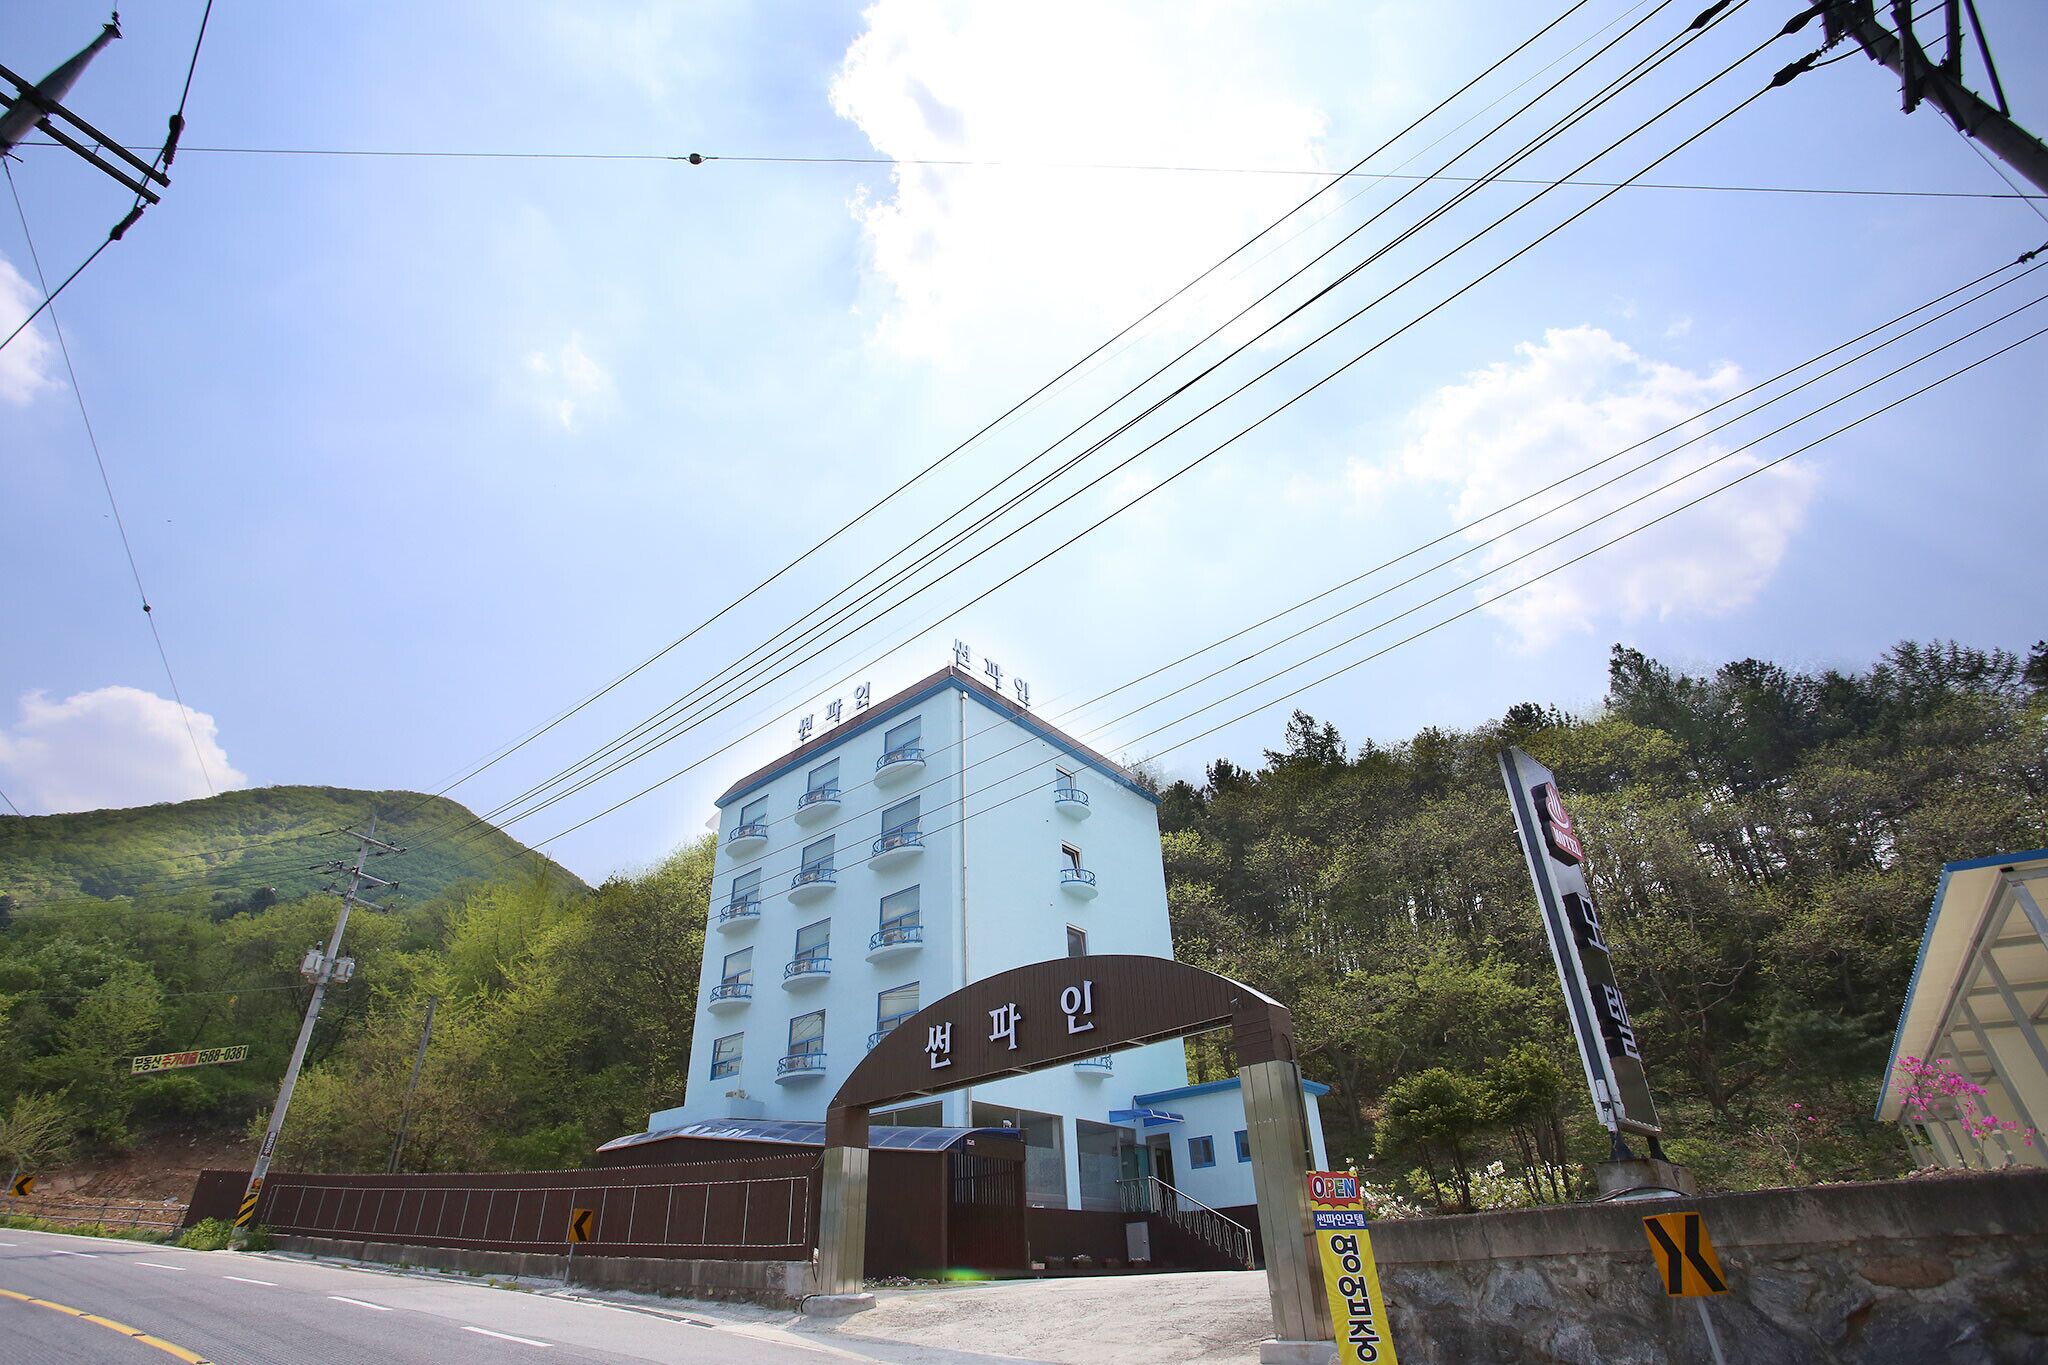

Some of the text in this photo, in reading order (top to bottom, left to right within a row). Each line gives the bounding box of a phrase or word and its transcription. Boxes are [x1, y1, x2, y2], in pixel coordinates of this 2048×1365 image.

[1551, 826, 1583, 857] MOTEL
[135, 1055, 163, 1071] 부동산
[198, 1046, 248, 1064] 1588-0381
[1312, 1176, 1357, 1199] OPEN
[1316, 1213, 1365, 1227] 썬파인모텔
[1330, 1234, 1380, 1362] 영업중
